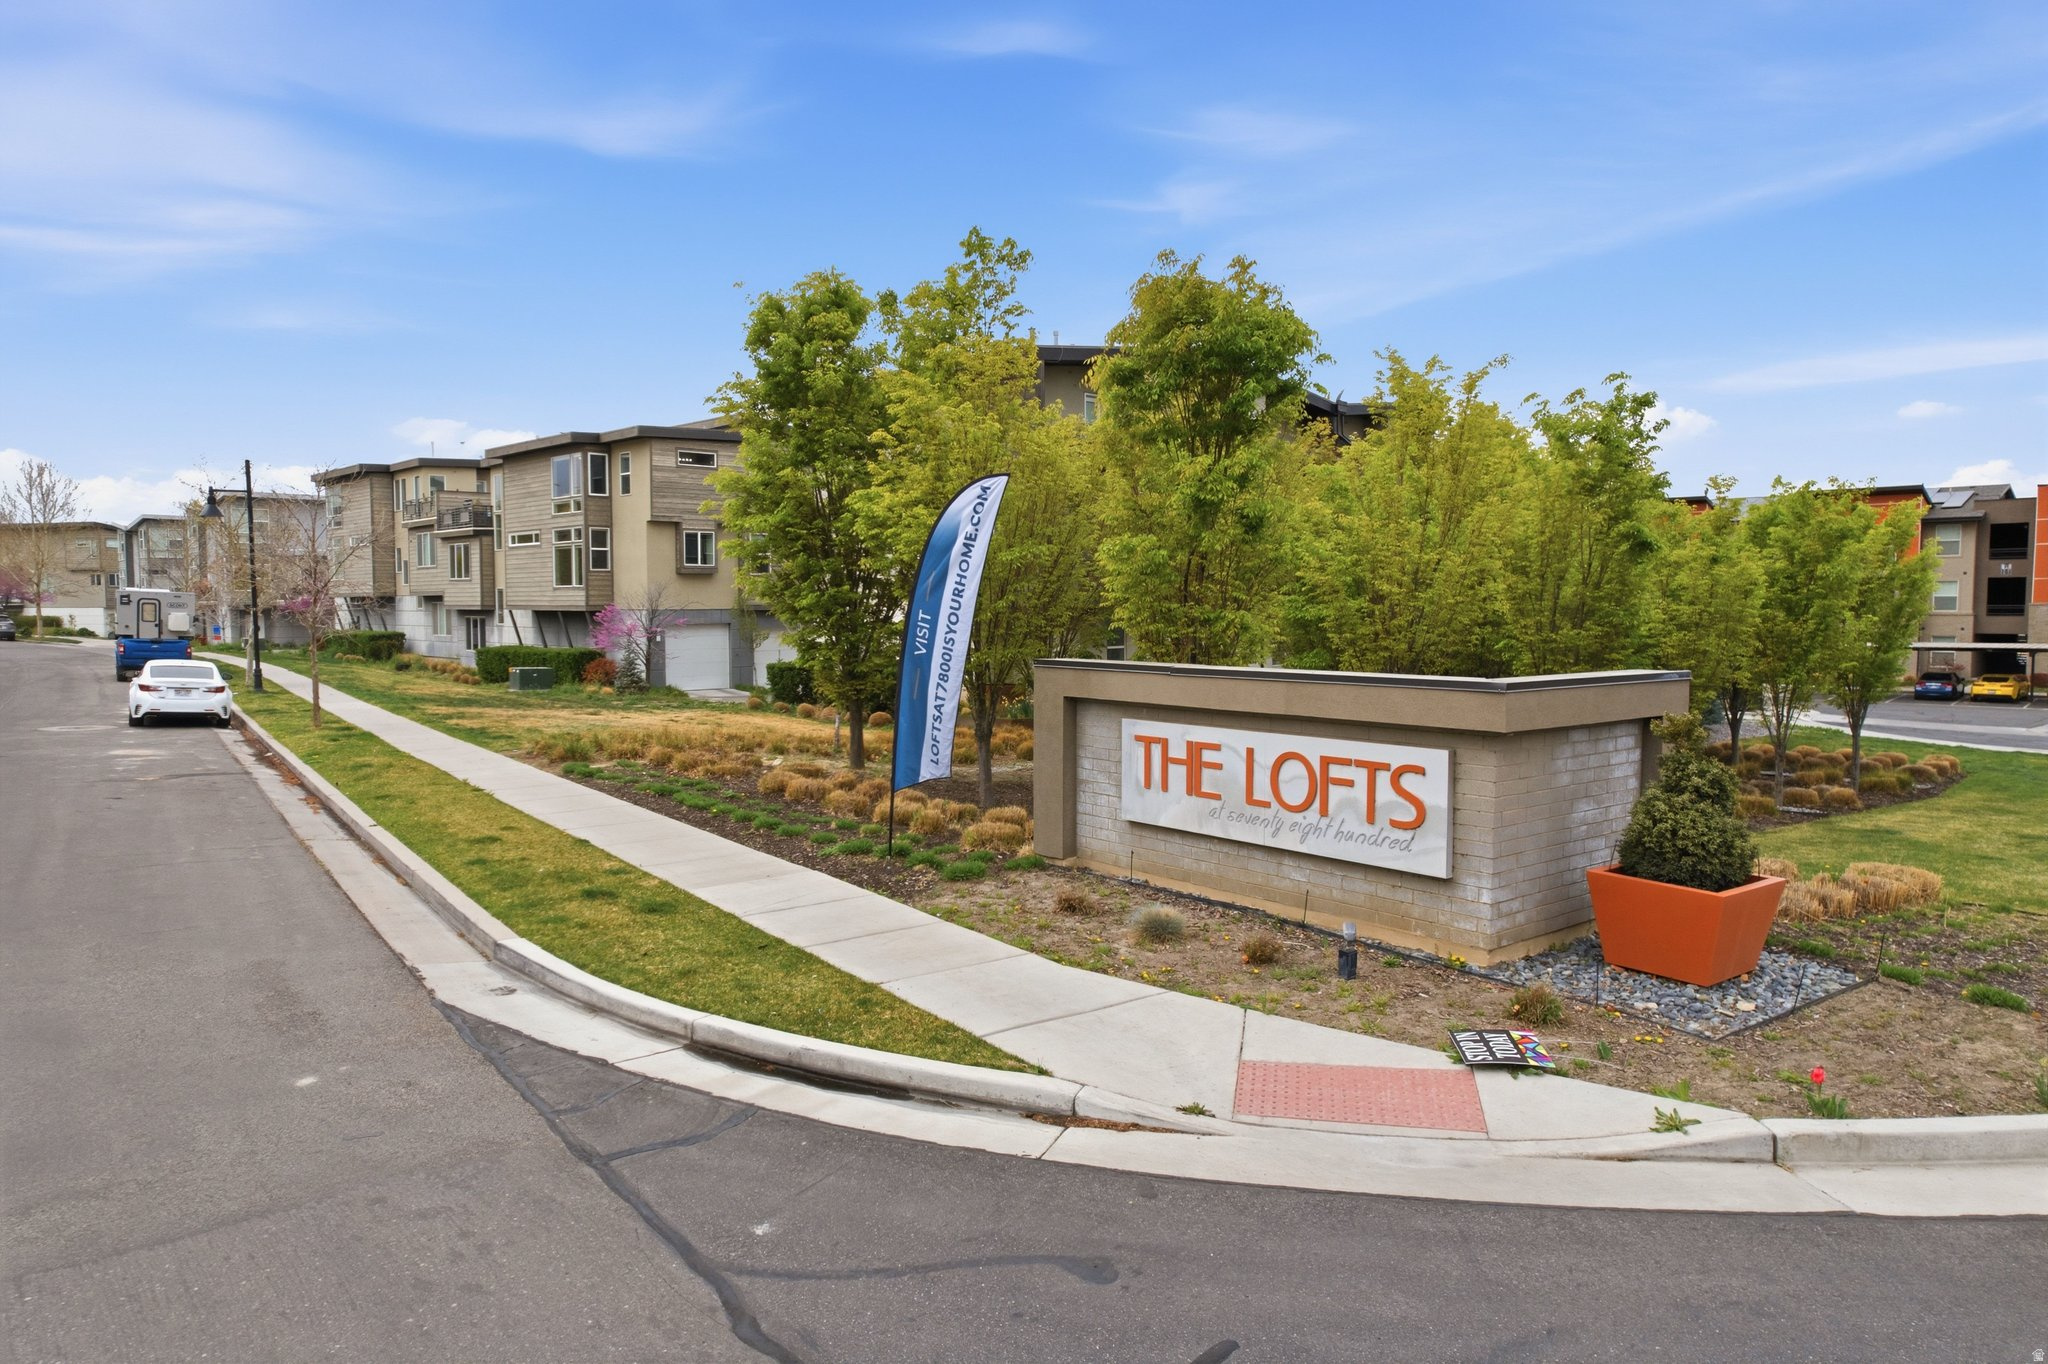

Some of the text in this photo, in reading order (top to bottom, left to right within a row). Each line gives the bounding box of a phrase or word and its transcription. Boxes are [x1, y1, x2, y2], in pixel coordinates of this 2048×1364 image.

[914, 609, 931, 655] VISIT
[930, 485, 991, 766] LOFTSAT7800ISYOURHOME.COM
[1134, 734, 1427, 830] THE LOFTS
[1208, 800, 1416, 852] at seventy eight hundred
[1454, 1032, 1493, 1061] STOP IN
[1483, 1032, 1521, 1059] TODAY
